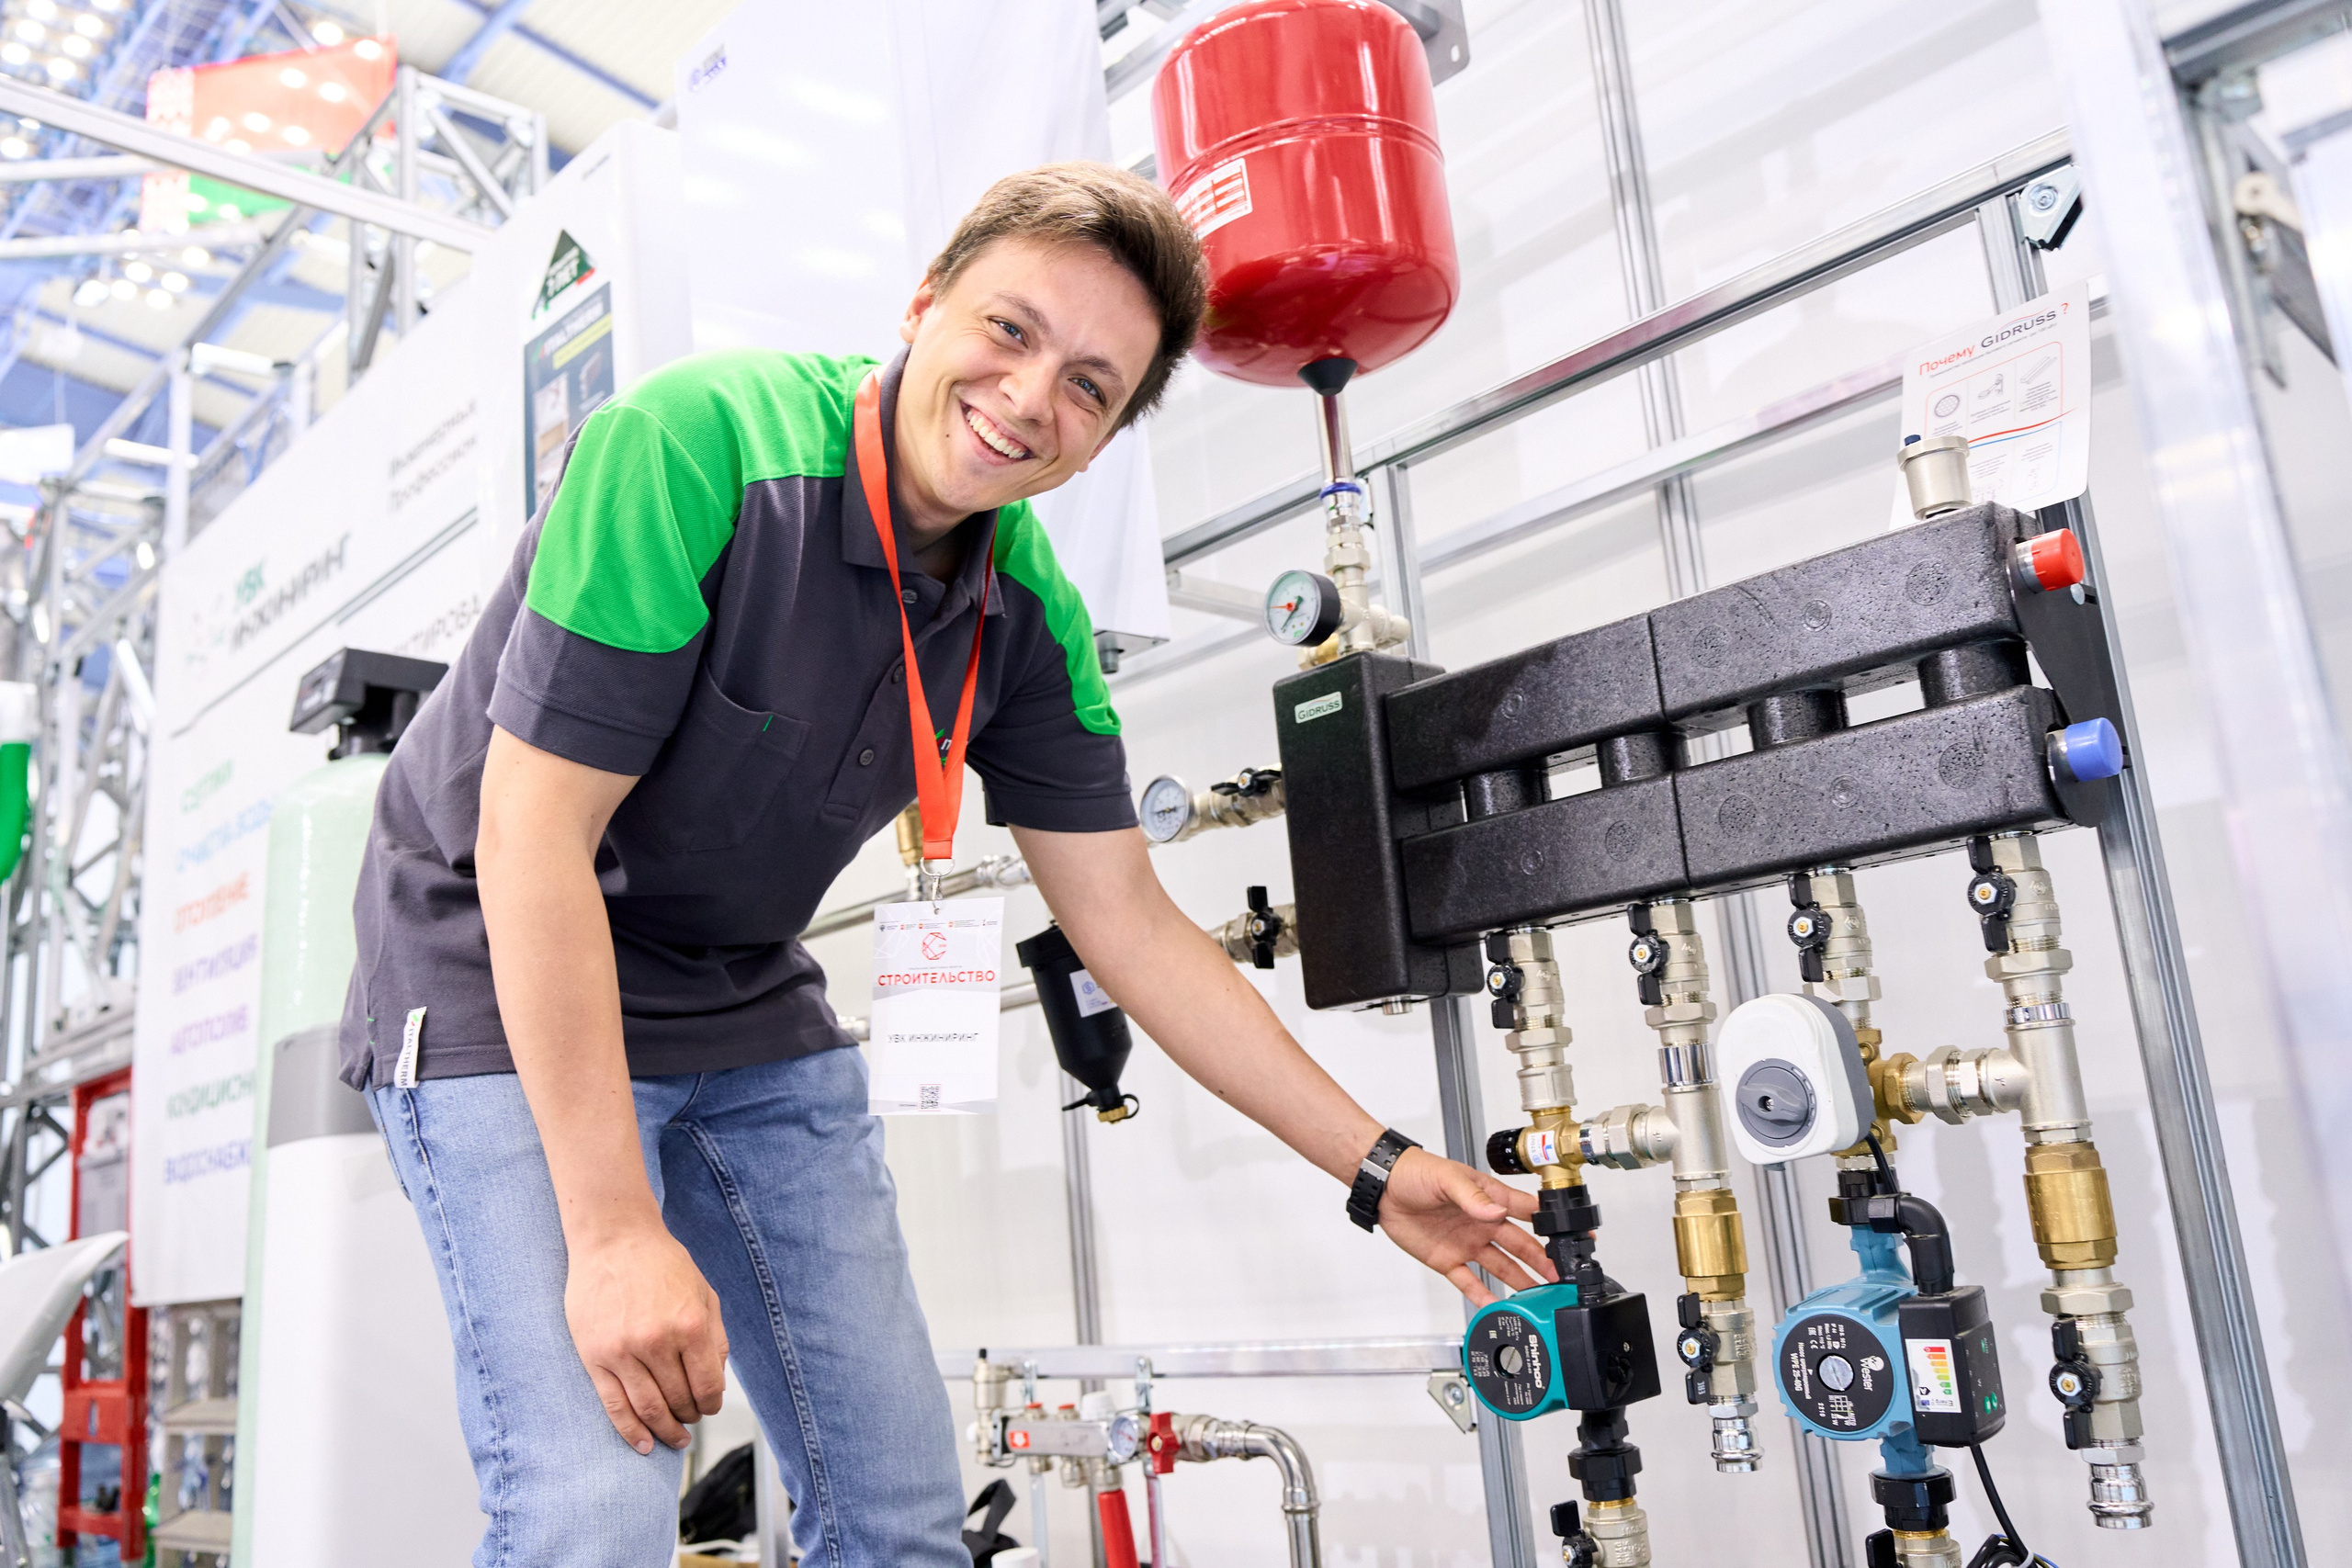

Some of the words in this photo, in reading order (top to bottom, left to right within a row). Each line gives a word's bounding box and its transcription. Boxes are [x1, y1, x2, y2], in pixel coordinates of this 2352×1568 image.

[1919, 345, 1975, 376] Почему
[1981, 310, 2057, 348] GIDRUSS
[1297, 700, 1340, 720] GIDRUSS
[877, 970, 996, 987] СТРОИТЕЛЬСТВО
[888, 1032, 906, 1043] УВК
[909, 1032, 979, 1043] ИНЖИНИРИНГ
[400, 1028, 414, 1087] ITALTHERM
[1529, 1334, 1543, 1389] Shinhoo
[1790, 1352, 1800, 1369] WPE
[1860, 1358, 1873, 1392] Wester
